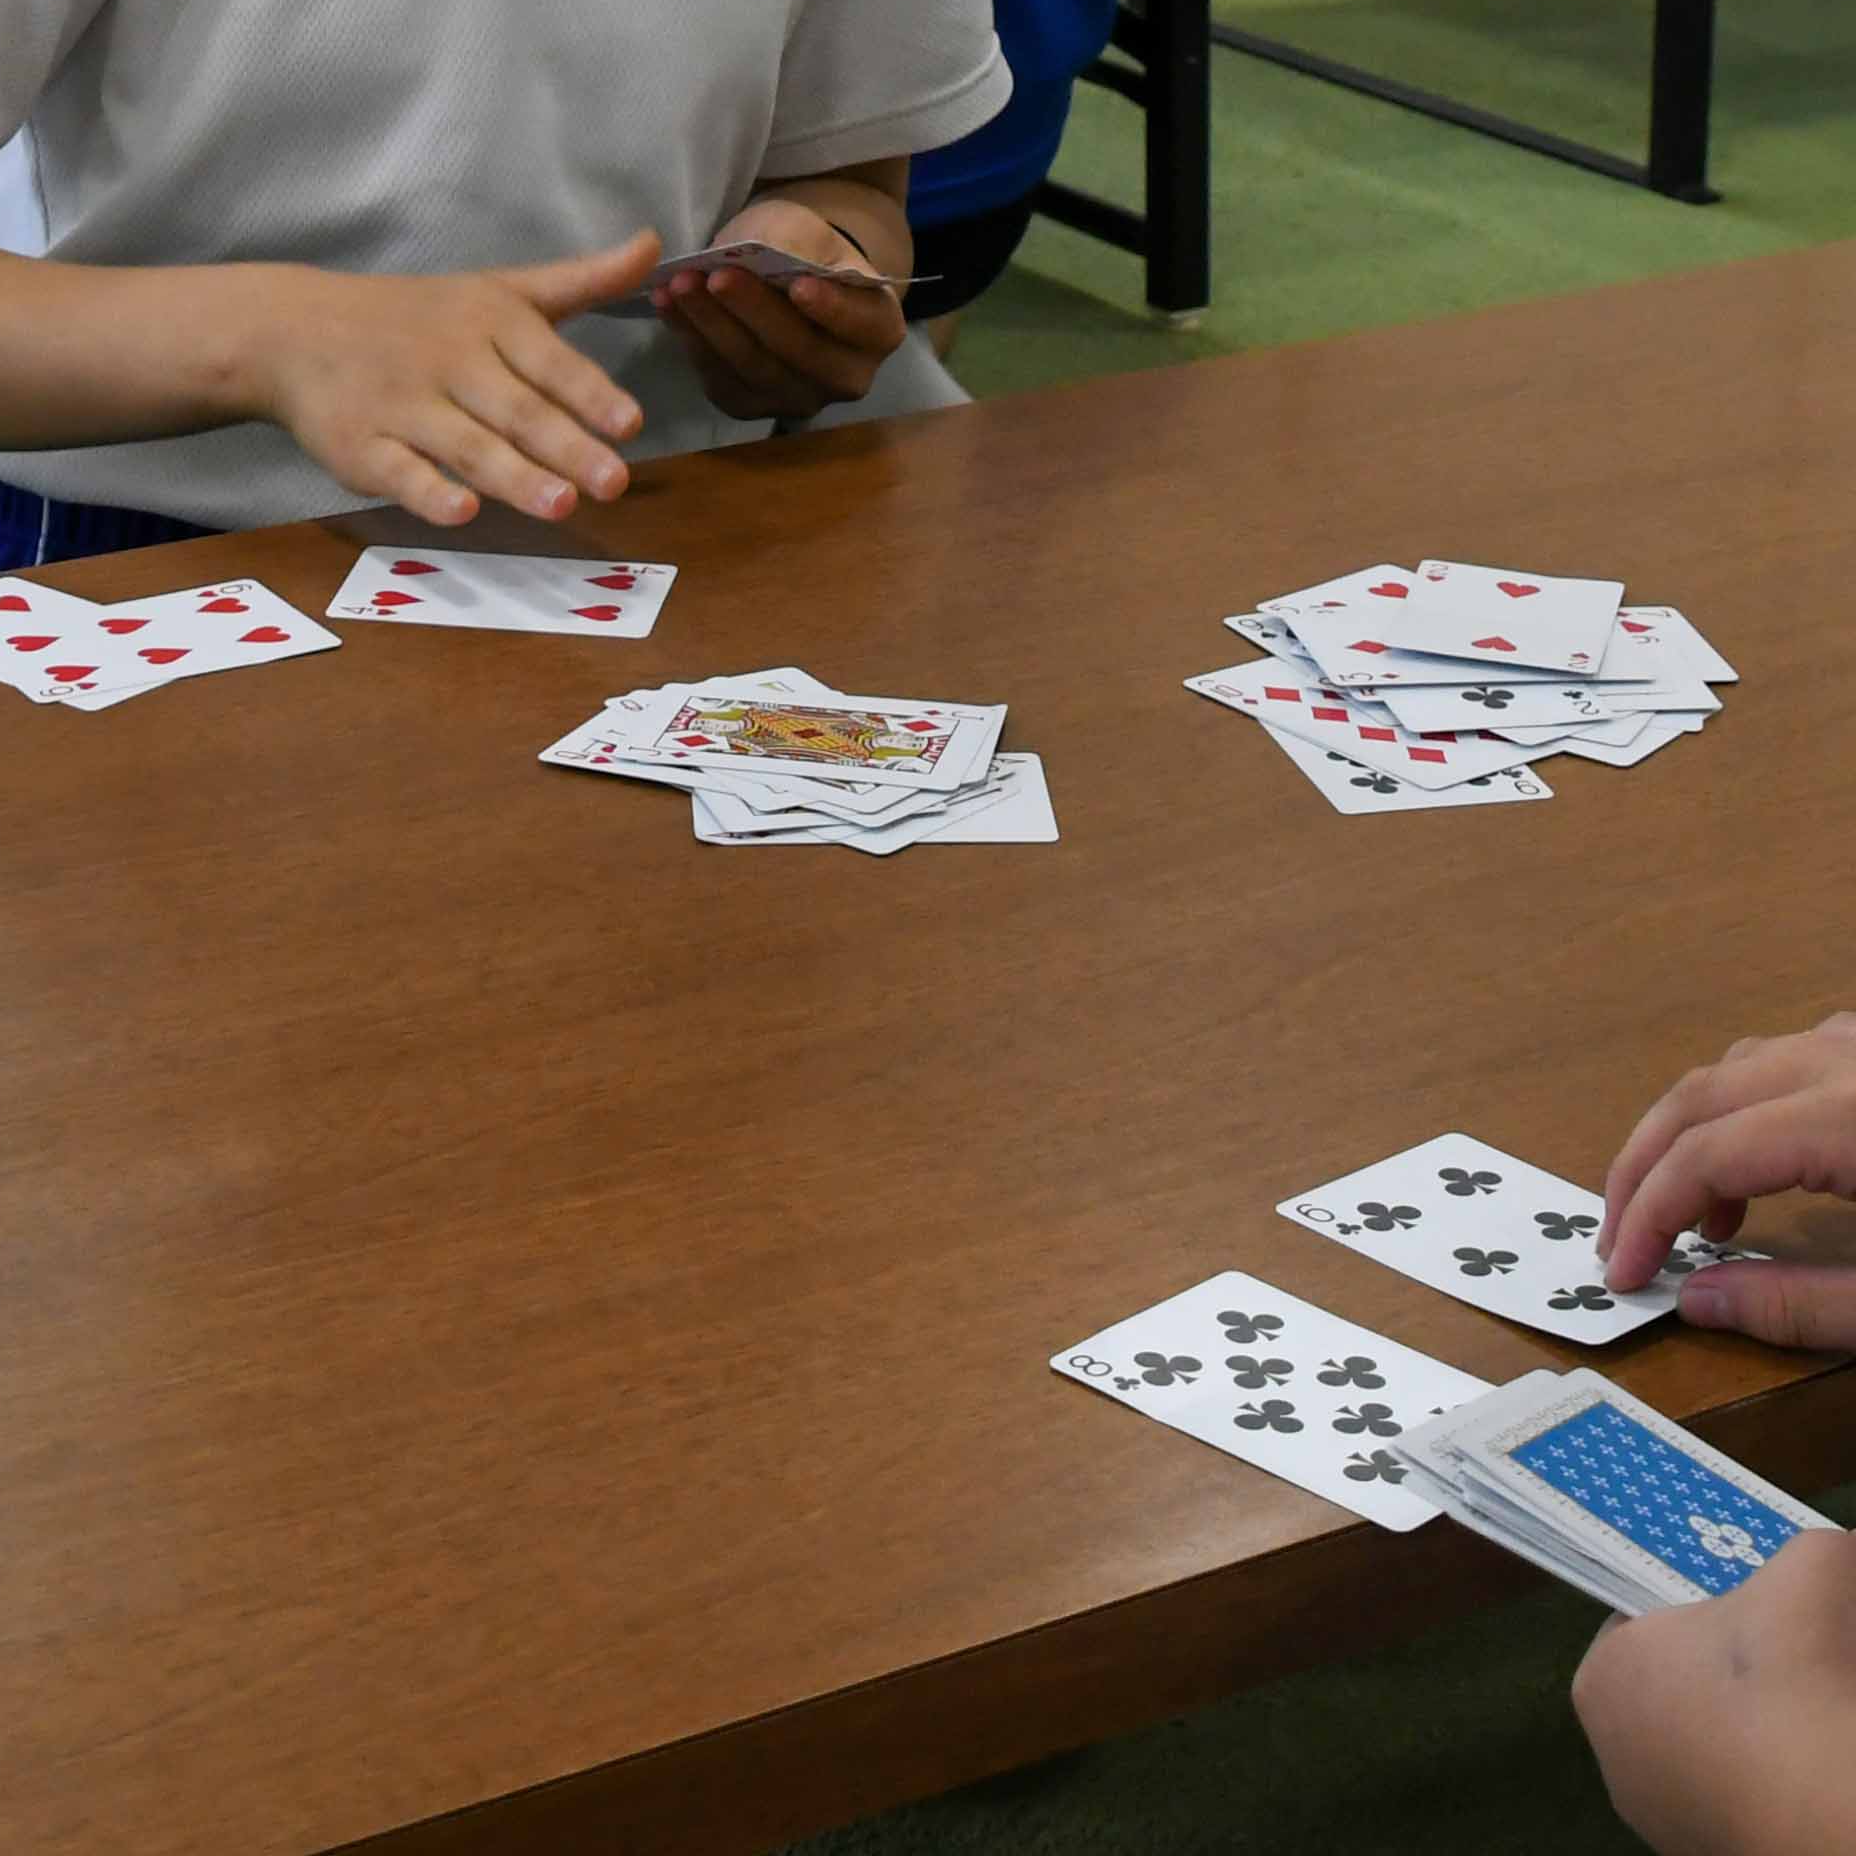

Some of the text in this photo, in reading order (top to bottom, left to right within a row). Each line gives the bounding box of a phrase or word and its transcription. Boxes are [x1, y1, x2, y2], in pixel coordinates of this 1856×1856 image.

[220, 584, 252, 594] 6
[341, 606, 373, 615] 4
[40, 685, 74, 696] 6
[1573, 700, 1600, 715] 2
[555, 750, 588, 760] Q
[628, 745, 661, 756] J
[1296, 1203, 1335, 1223] 6
[1069, 1355, 1112, 1377] 8
